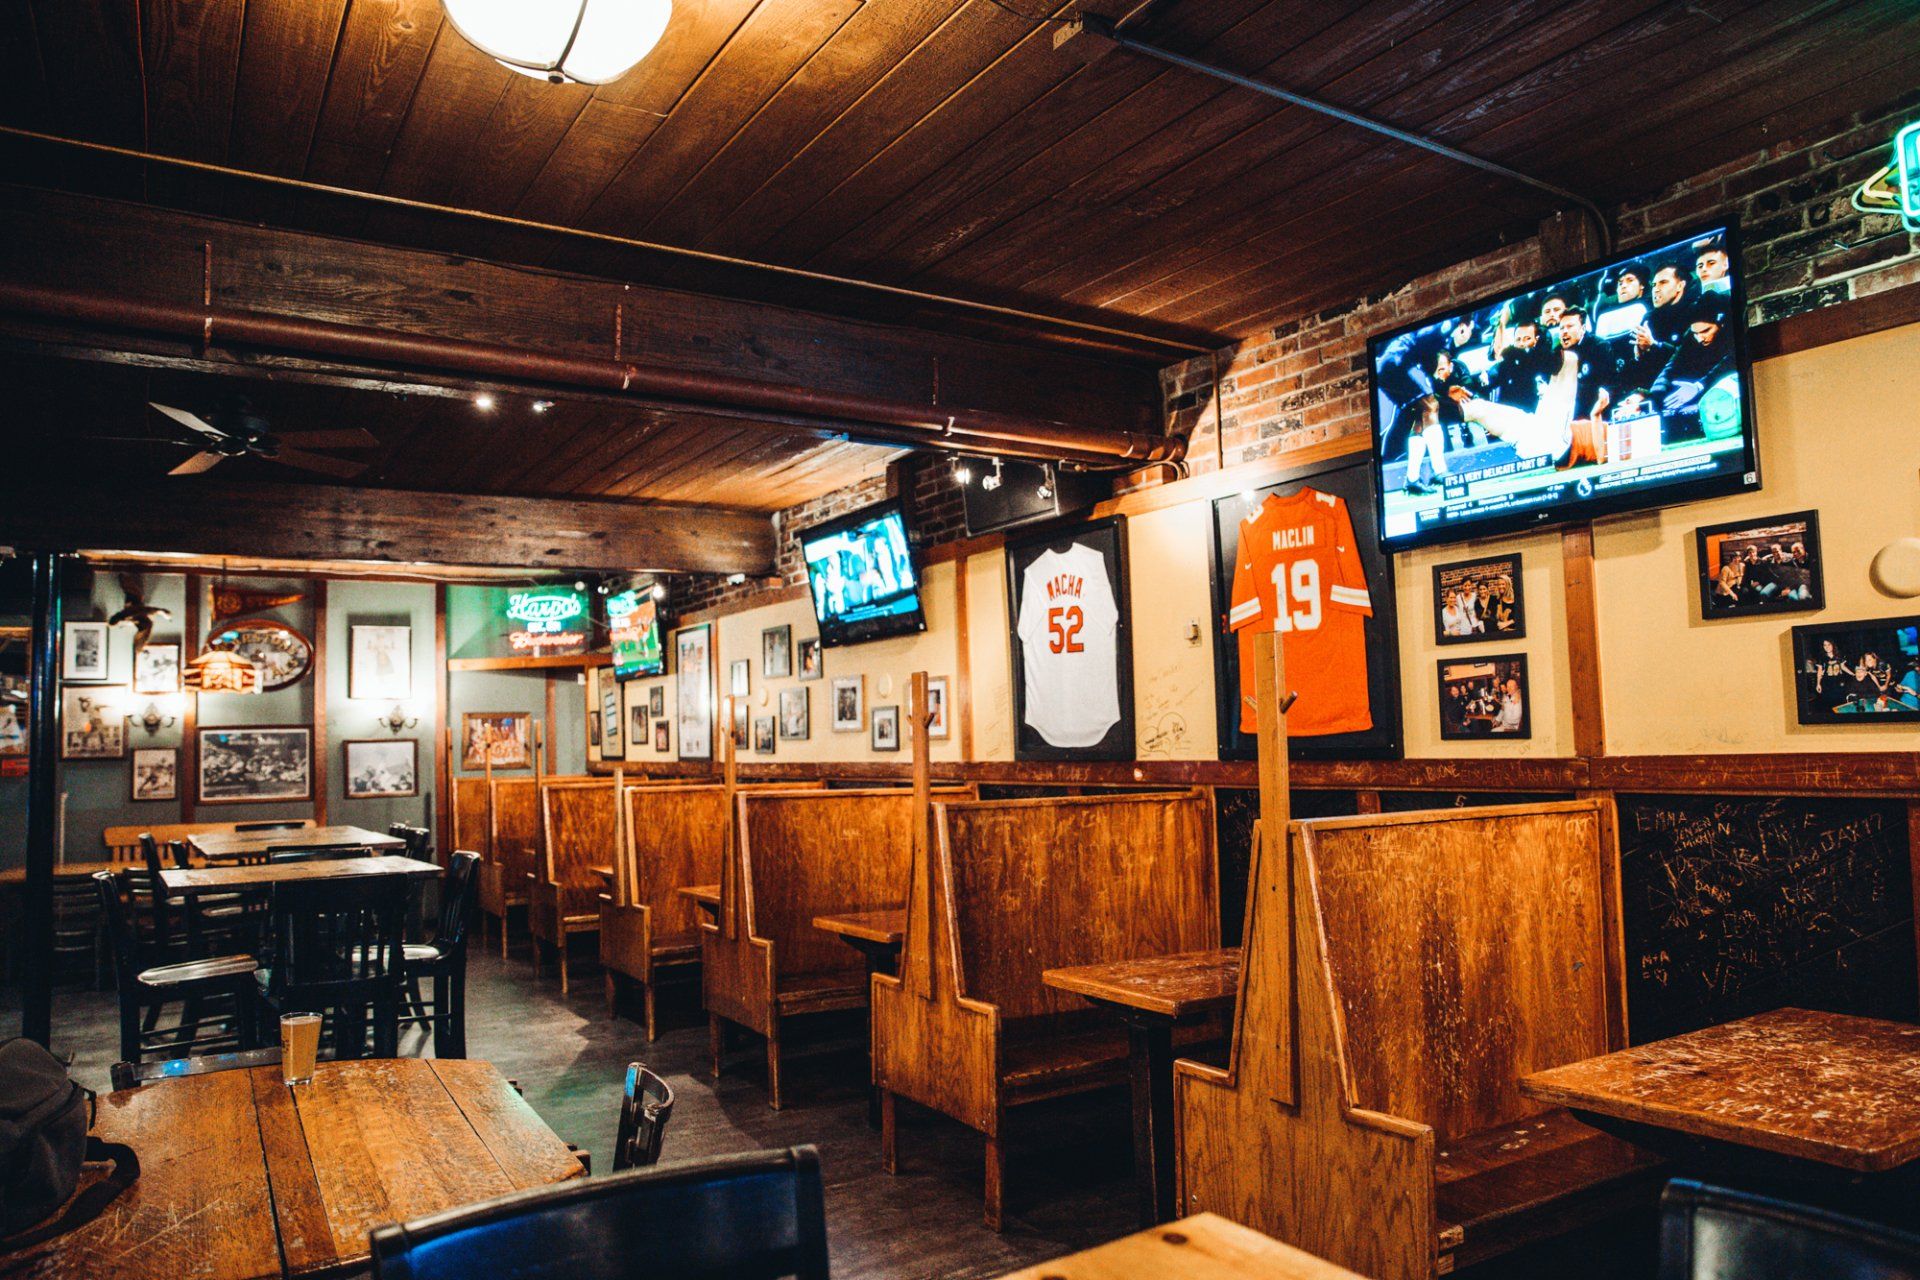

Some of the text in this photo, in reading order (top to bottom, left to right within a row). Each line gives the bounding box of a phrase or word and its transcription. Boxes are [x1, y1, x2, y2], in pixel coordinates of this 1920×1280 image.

[1464, 470, 1482, 482] VERY
[1483, 464, 1516, 479] DELICATE
[1517, 458, 1536, 471] PART
[1536, 455, 1548, 467] OF
[1272, 525, 1315, 551] MACLIN
[1271, 558, 1322, 633] 19
[509, 632, 584, 649] Budweiser
[1048, 605, 1084, 654] 52
